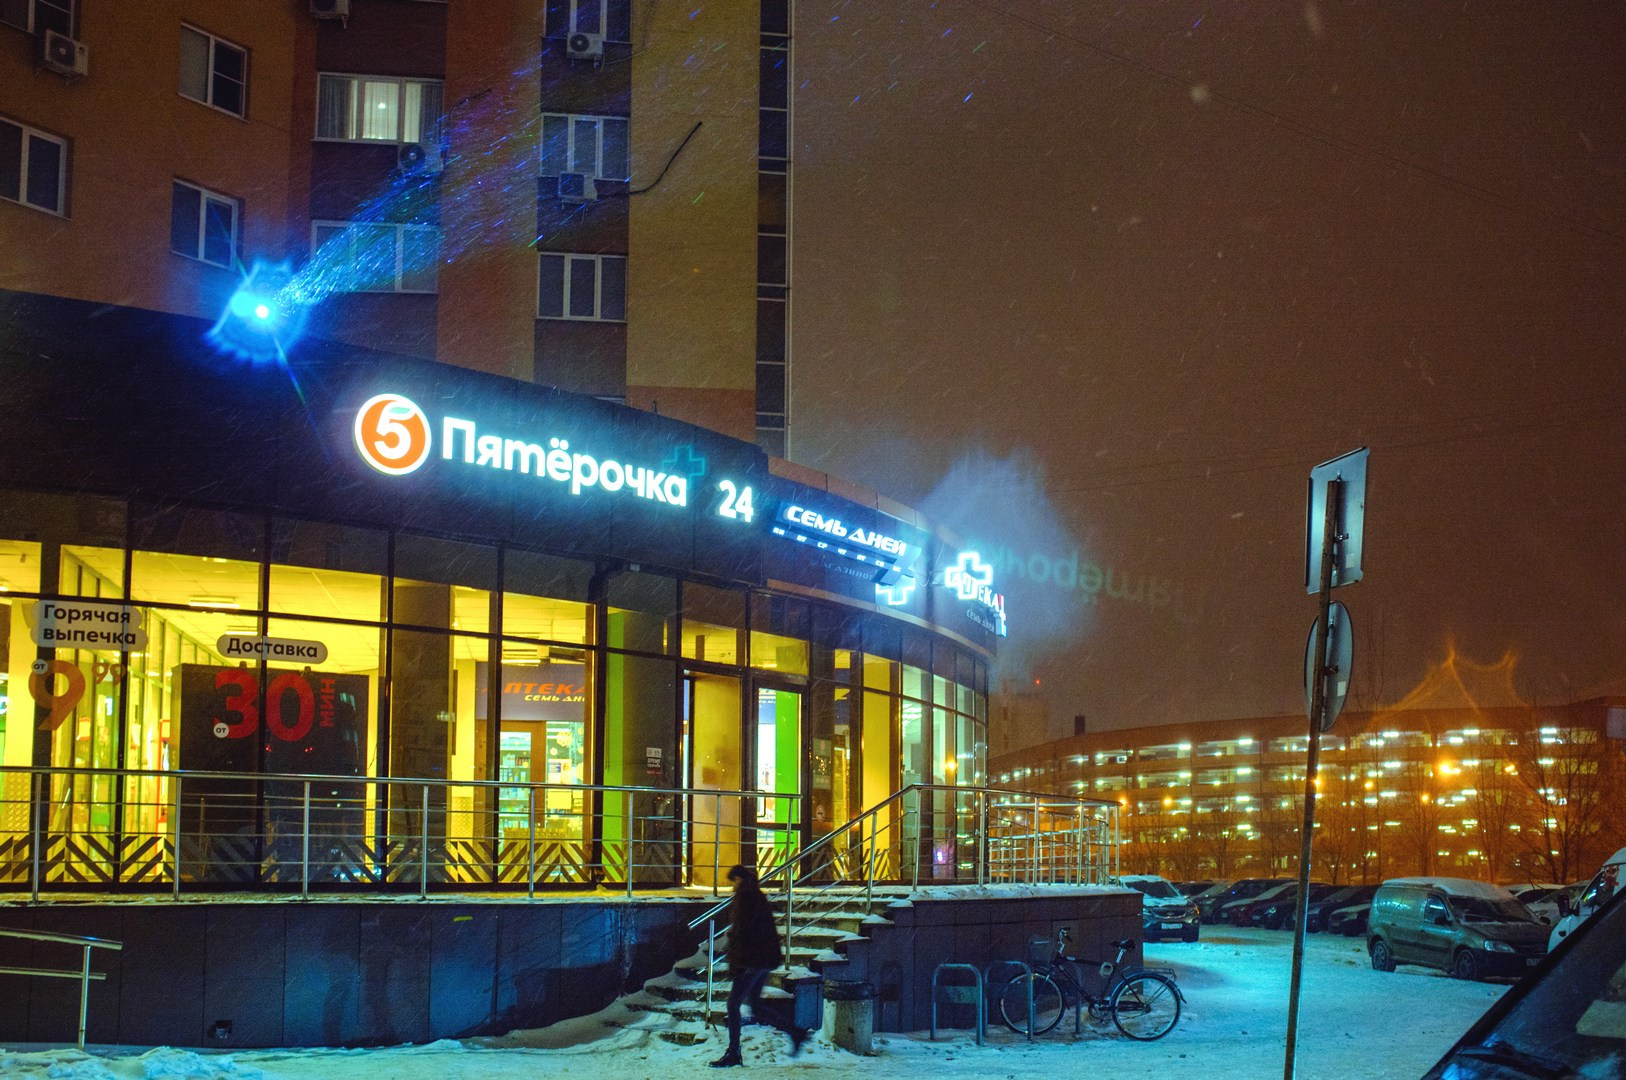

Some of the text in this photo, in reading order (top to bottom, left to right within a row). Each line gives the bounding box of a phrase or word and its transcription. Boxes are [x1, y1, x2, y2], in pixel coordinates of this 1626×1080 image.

[374, 401, 415, 460] 5
[442, 416, 687, 507] Пятёрочка
[719, 480, 754, 523] 24
[787, 505, 907, 557] СЕМЬ ДНЕЙ
[43, 604, 131, 625] Горячая
[43, 626, 137, 646] выпечка
[227, 637, 318, 659] Доставка
[28, 660, 86, 730] 9
[91, 662, 126, 685] 99
[214, 669, 315, 742] 30
